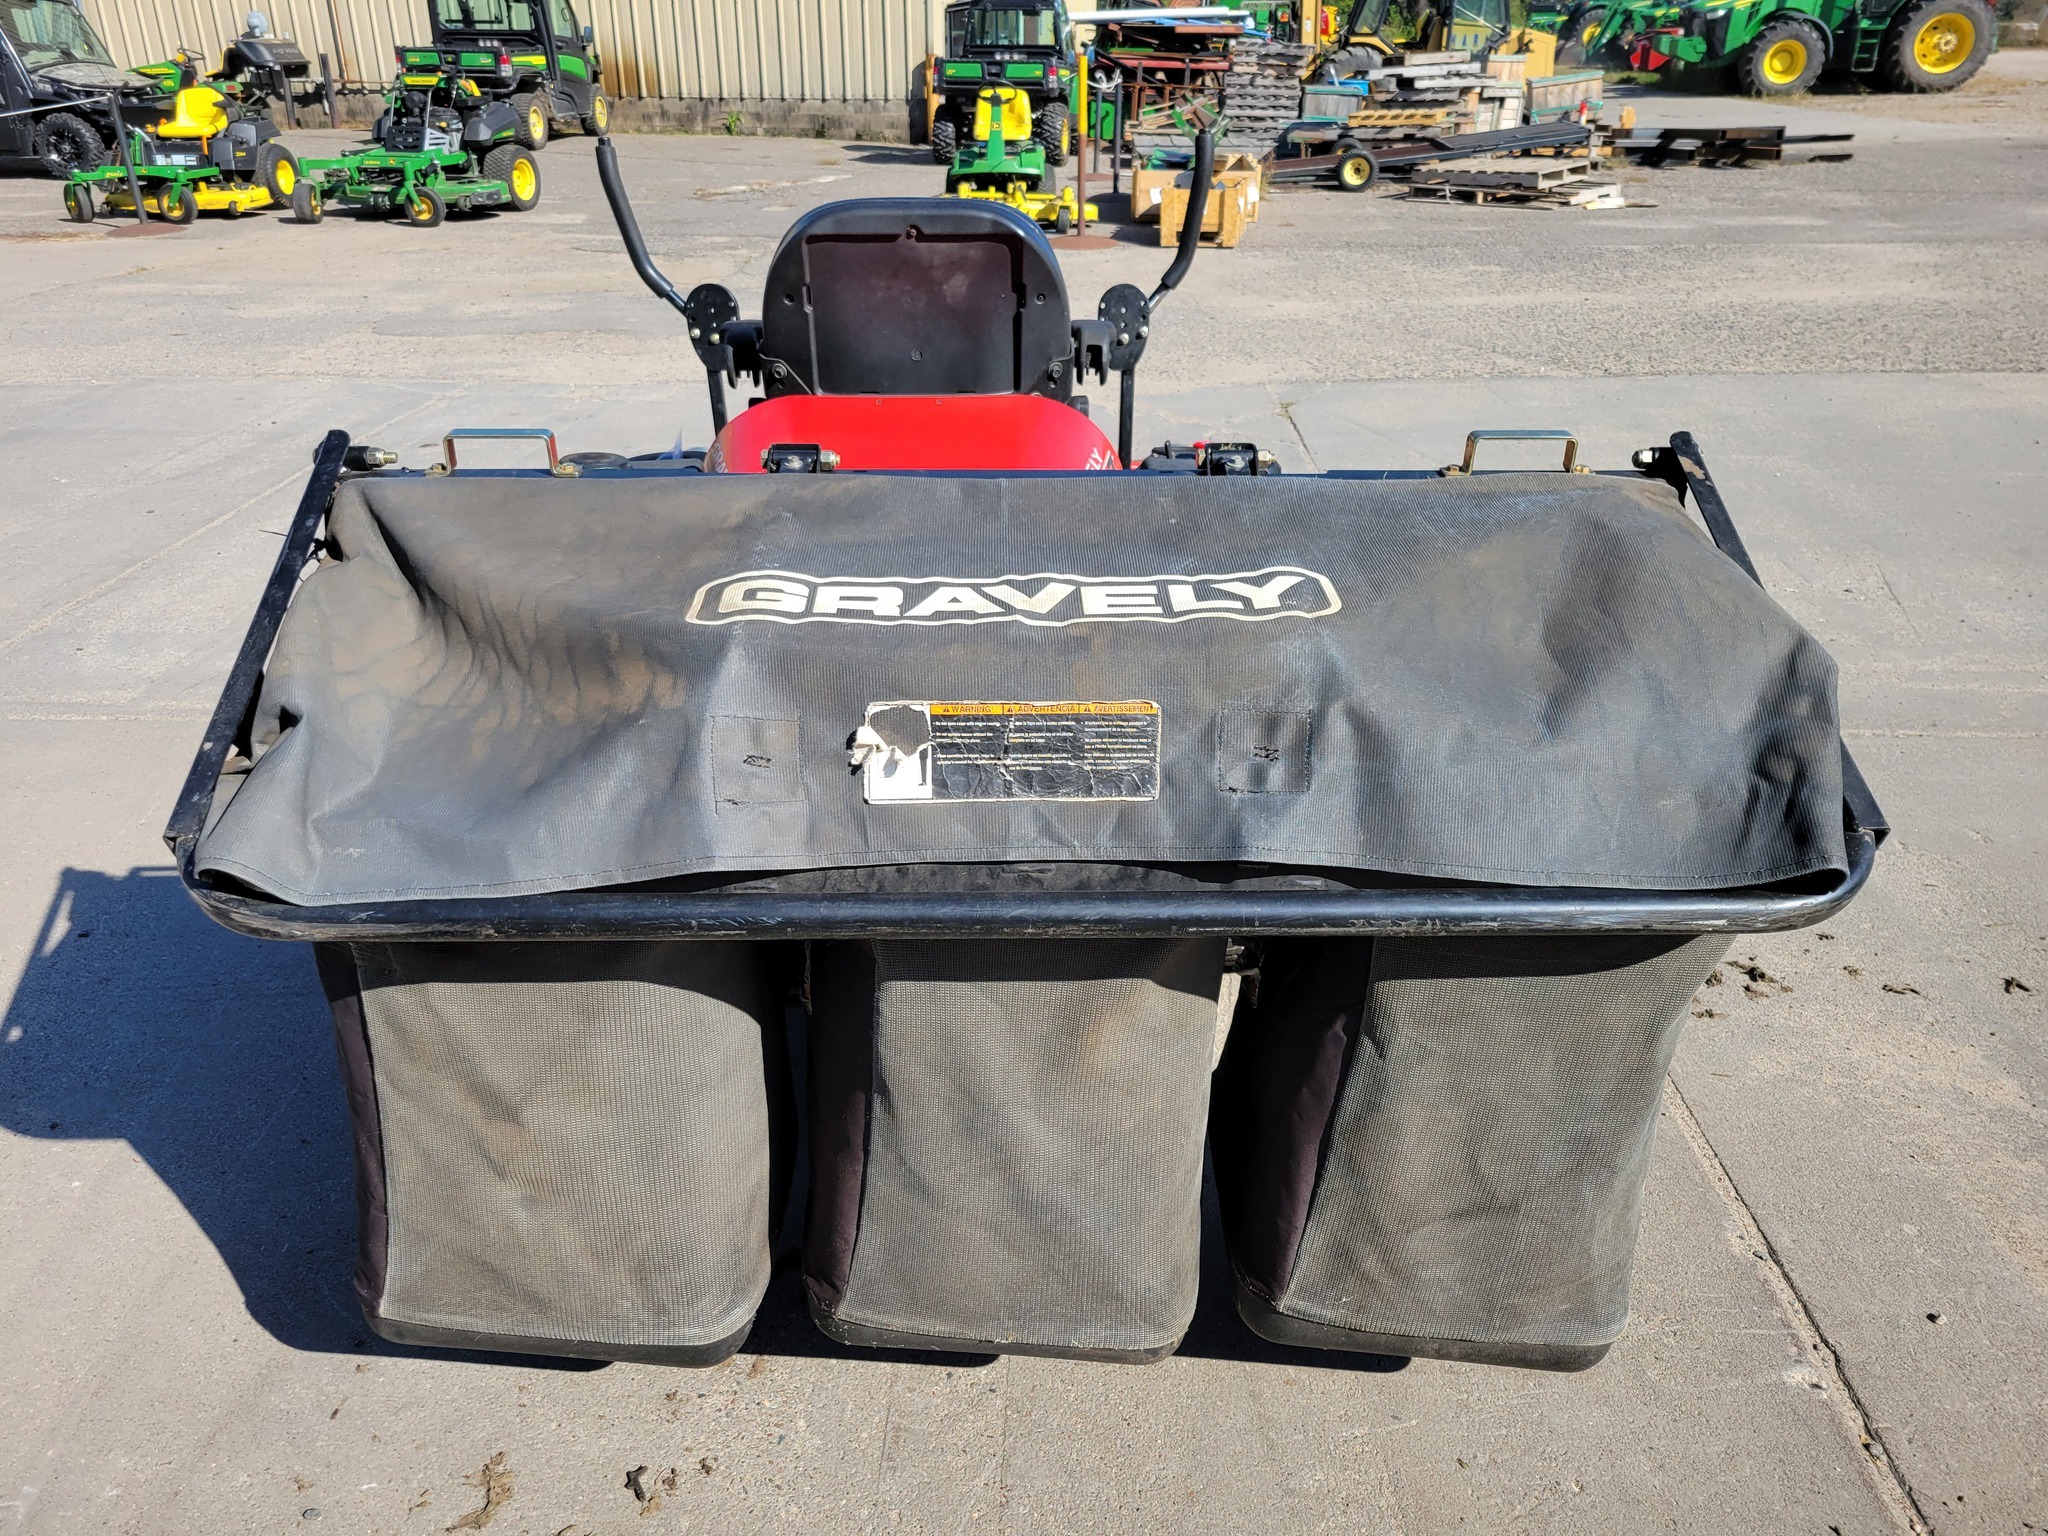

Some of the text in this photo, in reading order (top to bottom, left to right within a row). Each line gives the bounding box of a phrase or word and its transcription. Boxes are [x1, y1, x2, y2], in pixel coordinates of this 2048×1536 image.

[712, 443, 729, 473] GRA
[718, 576, 1306, 617] GRAVELY
[951, 705, 991, 713] WARNING
